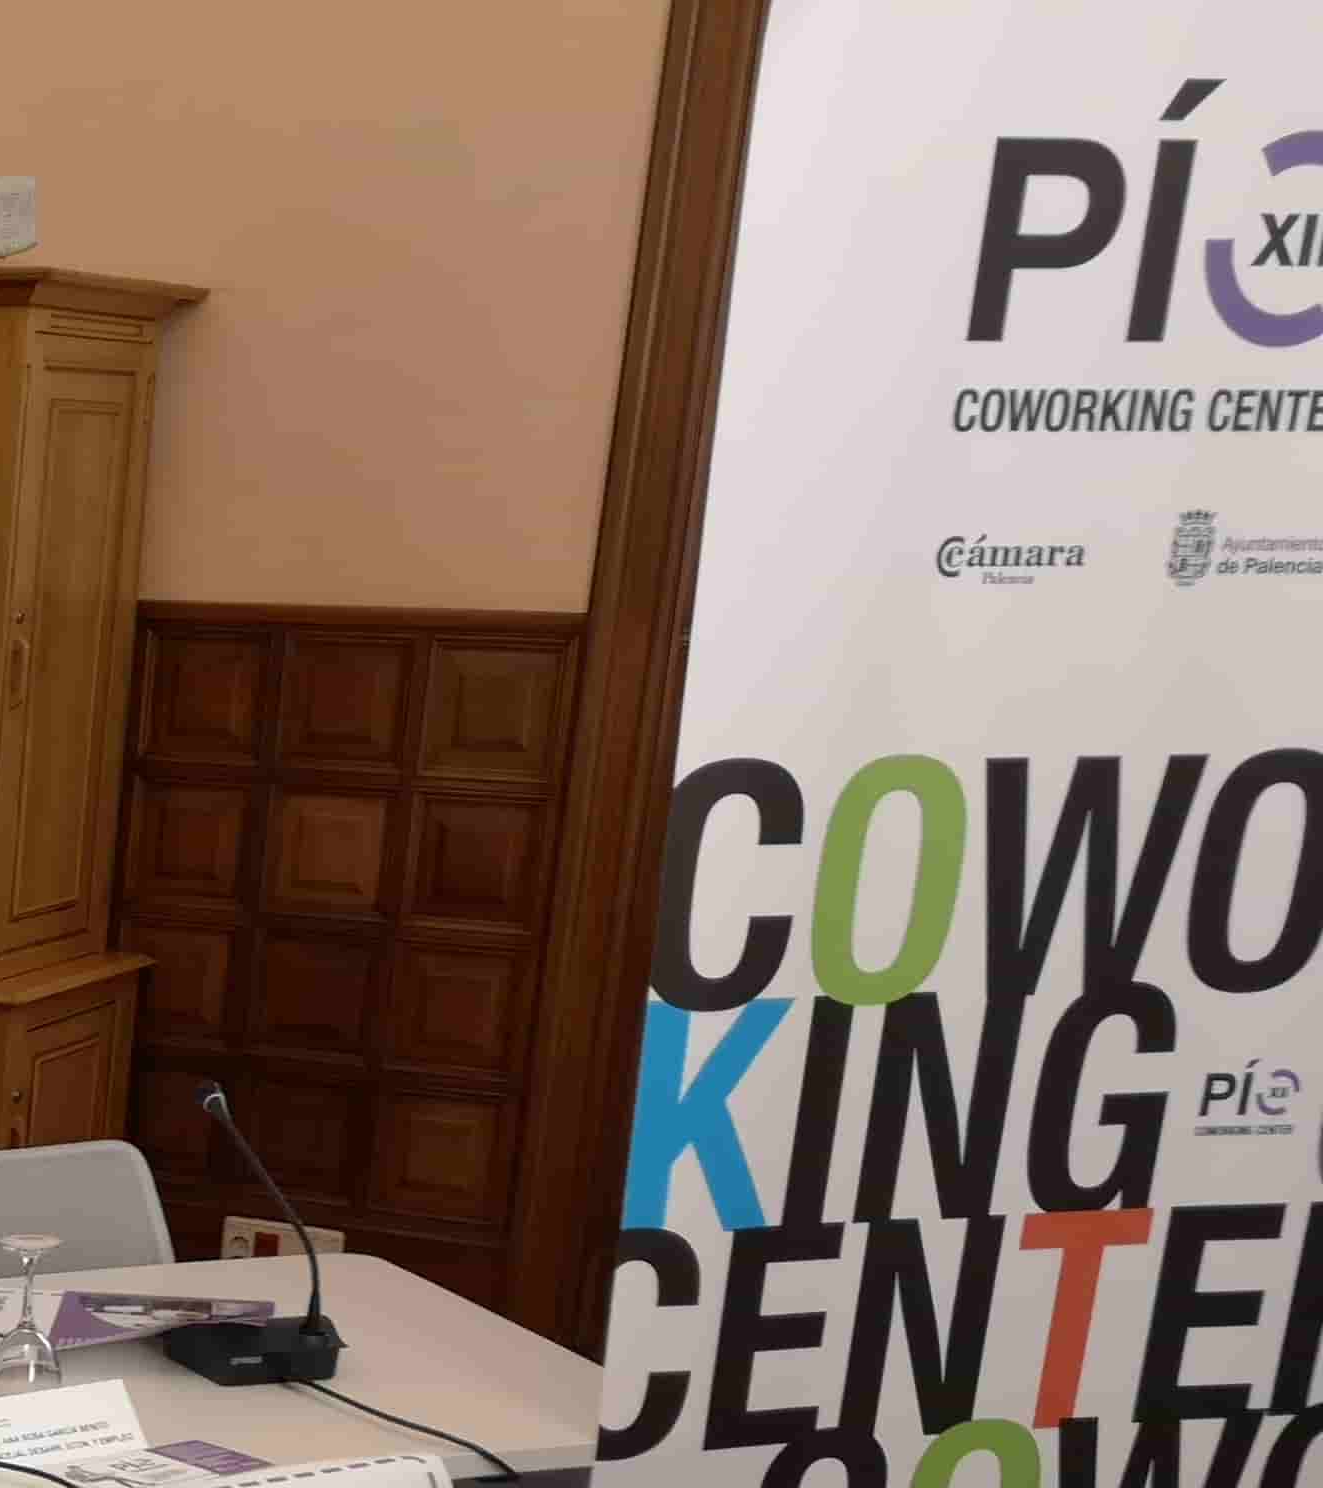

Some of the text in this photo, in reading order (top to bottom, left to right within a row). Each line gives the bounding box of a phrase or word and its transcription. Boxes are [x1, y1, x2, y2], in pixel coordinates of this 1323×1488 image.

[1251, 213, 1323, 267] XI
[952, 387, 1323, 434] COWORKING CENTE
[649, 747, 1323, 1012] COWO
[620, 981, 1177, 1232] KING
